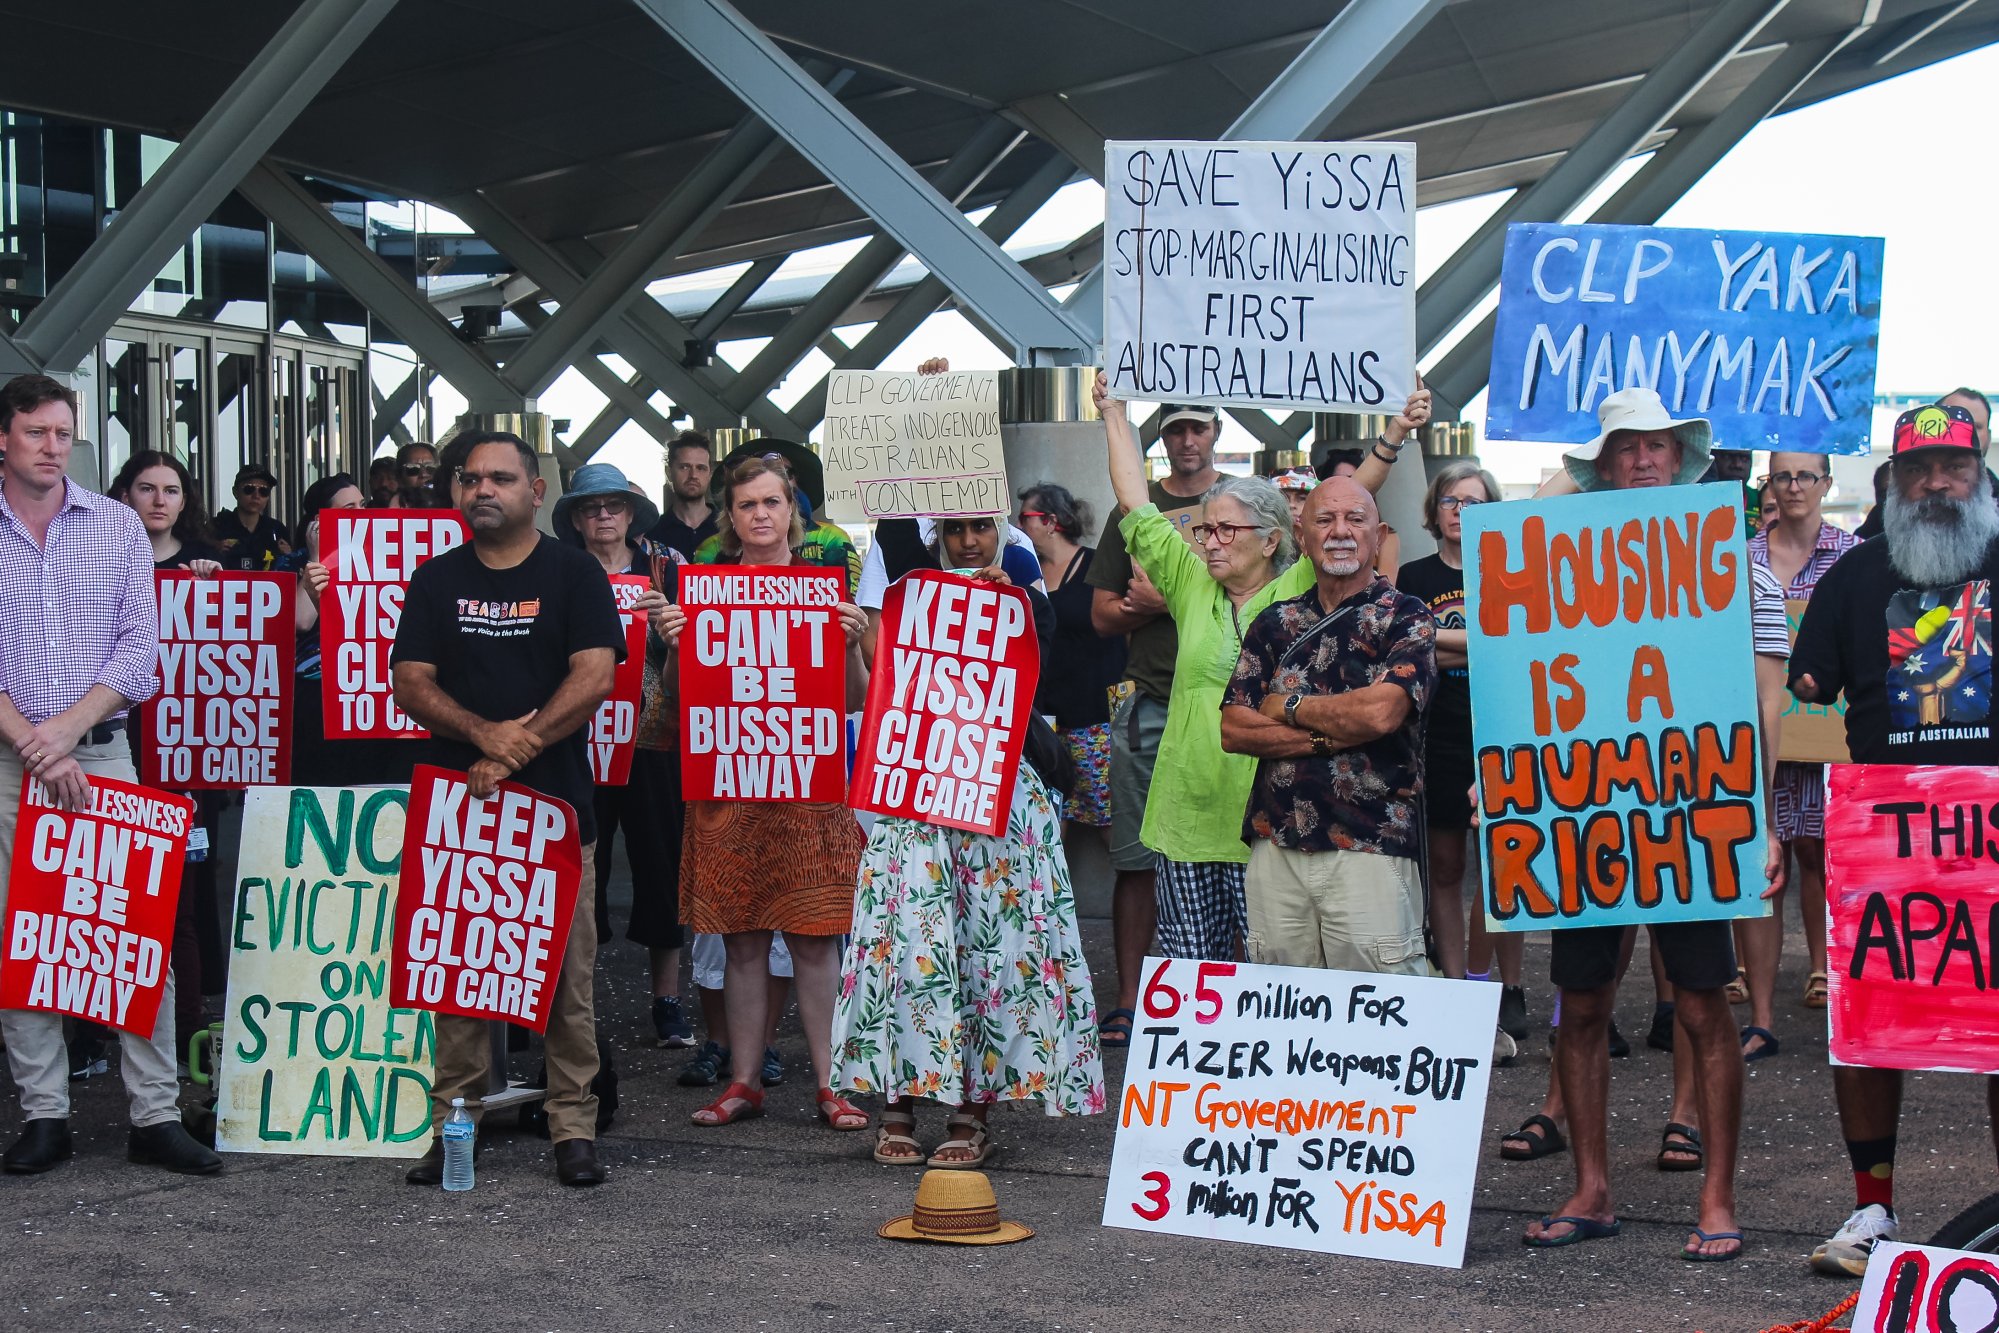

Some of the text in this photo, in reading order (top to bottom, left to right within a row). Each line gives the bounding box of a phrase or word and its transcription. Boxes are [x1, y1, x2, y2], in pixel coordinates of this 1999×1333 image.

[1122, 148, 1240, 207] SAVE
[1531, 237, 1859, 315] CLP YAKA
[1205, 293, 1315, 342] FIRST
[831, 374, 994, 405] CLP GOVERMENT
[1113, 340, 1385, 405] AUSTRALIANS
[1519, 323, 1853, 422] MANYMAK
[826, 411, 999, 442] TREATS INDIGENOUS
[825, 443, 990, 473] AUSTRALIANS
[825, 477, 1003, 513] WITH CONTEMPT
[684, 576, 839, 607] HOMELESSNESS
[1478, 505, 1738, 637] HOUSING
[160, 580, 282, 641] KEEP
[457, 598, 518, 619] TEABBA
[477, 627, 494, 636] Voice
[501, 629, 513, 637] the
[513, 627, 530, 636] Bush
[696, 610, 828, 668] CAN'T
[898, 577, 1026, 664] KEEP
[158, 645, 280, 698] YISSA
[732, 667, 796, 703] BE
[892, 648, 1018, 729] YISSA
[1529, 644, 1675, 737] IS A
[156, 698, 280, 747] CLOSE
[338, 694, 375, 731] TO
[689, 707, 838, 757] BUSSED
[1888, 726, 1990, 745] FIRST AUSTRALIAN
[157, 746, 277, 784] TO CARE
[713, 755, 819, 799] AWAY
[875, 710, 1010, 787] CLOSE
[1478, 721, 1756, 815] HUMAN
[424, 778, 566, 864] KEEP
[871, 763, 997, 828] TO CARE
[31, 813, 173, 897] CAN'T
[285, 788, 410, 877] NO
[1485, 800, 1757, 920] RIGHT
[62, 876, 130, 925] BE
[234, 878, 398, 956] EVICTI
[421, 848, 558, 927] YISSA
[9, 910, 163, 988] BUSSED
[407, 906, 552, 983] CLOSE
[1849, 890, 1999, 992] APA
[27, 962, 137, 1026] AWAY
[320, 960, 385, 1001] ON
[406, 961, 541, 1024] TO CARE
[1142, 959, 1237, 1025] 6.5
[1237, 983, 1332, 1023] million
[1143, 1026, 1273, 1079] TAZER
[1405, 1046, 1479, 1101] BUT
[259, 1067, 433, 1145] LAND
[1122, 1080, 1190, 1128] NT
[1183, 1133, 1415, 1177] CAN'T SPEND
[1131, 1170, 1172, 1221] 3
[1186, 1180, 1259, 1225] million
